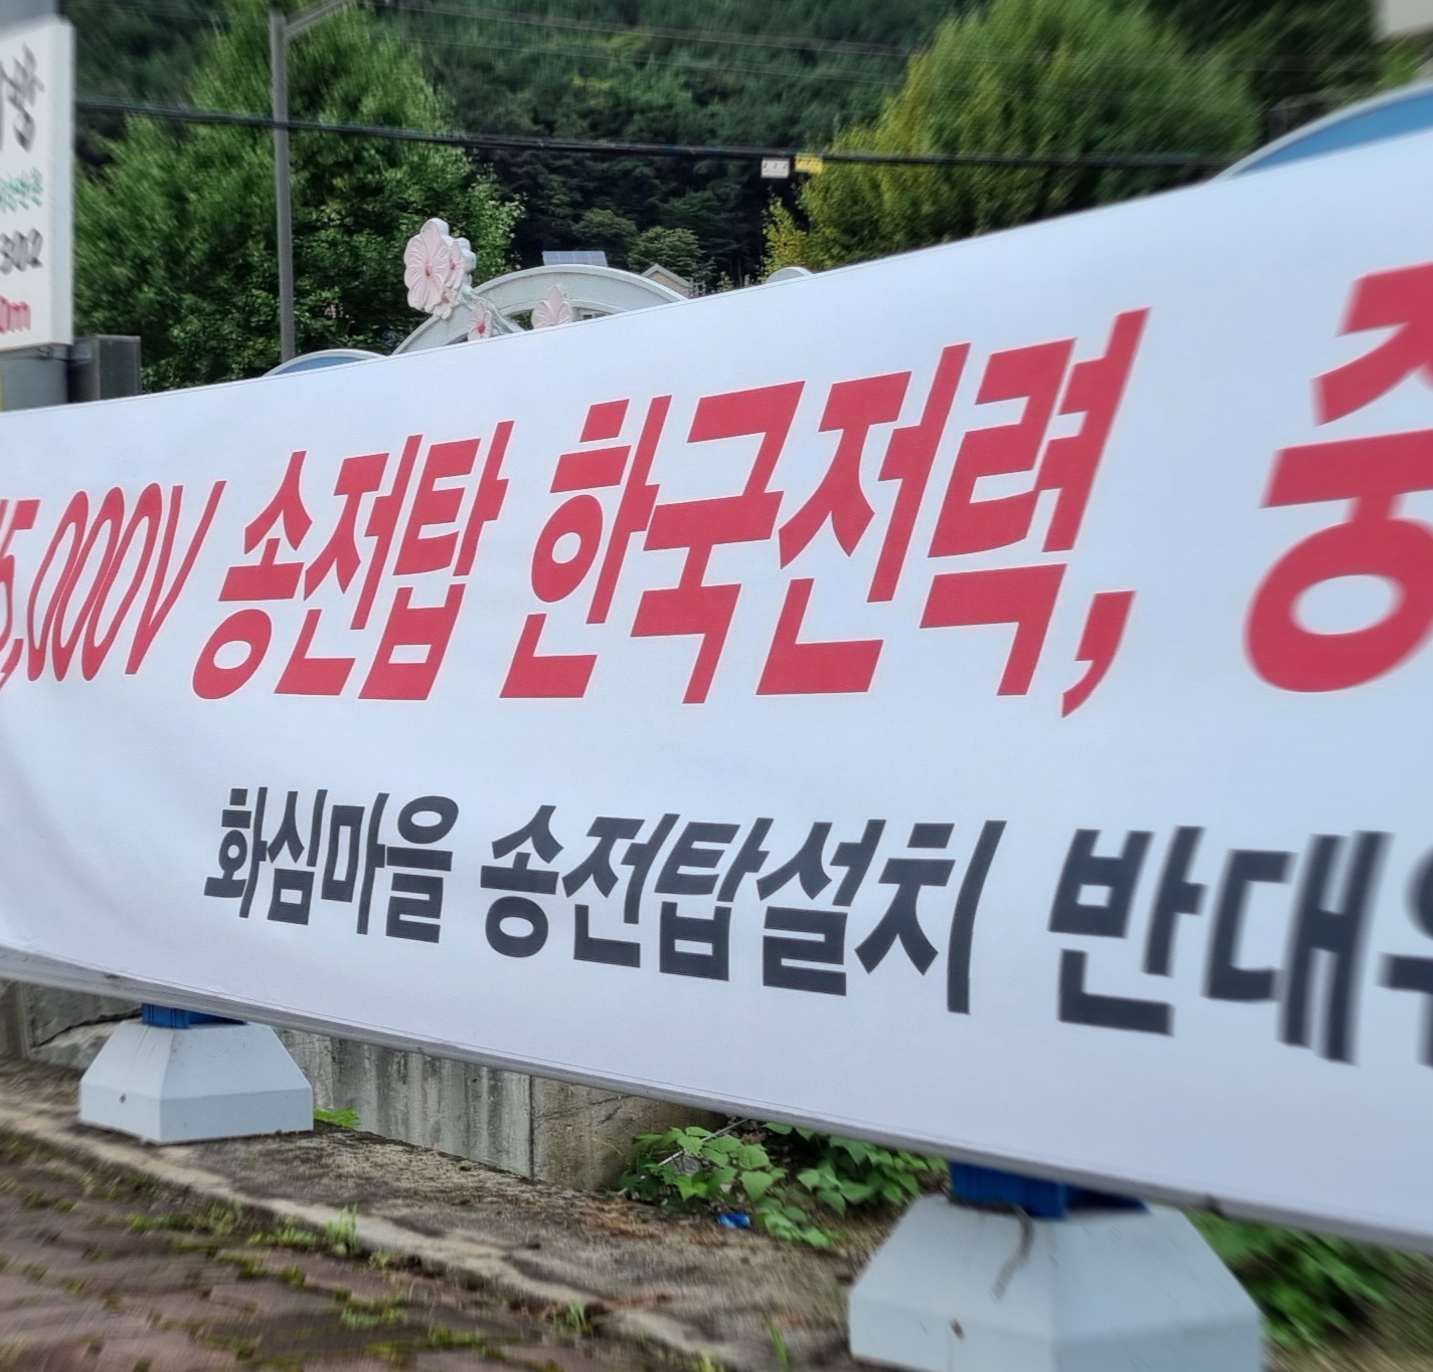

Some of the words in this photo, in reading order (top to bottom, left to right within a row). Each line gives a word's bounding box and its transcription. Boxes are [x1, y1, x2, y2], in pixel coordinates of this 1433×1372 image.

[191, 419, 515, 701] 송전탑
[499, 306, 1152, 718] 한국전력,
[203, 786, 460, 945] 화심마을
[478, 804, 1007, 1015] 송전탑설치
